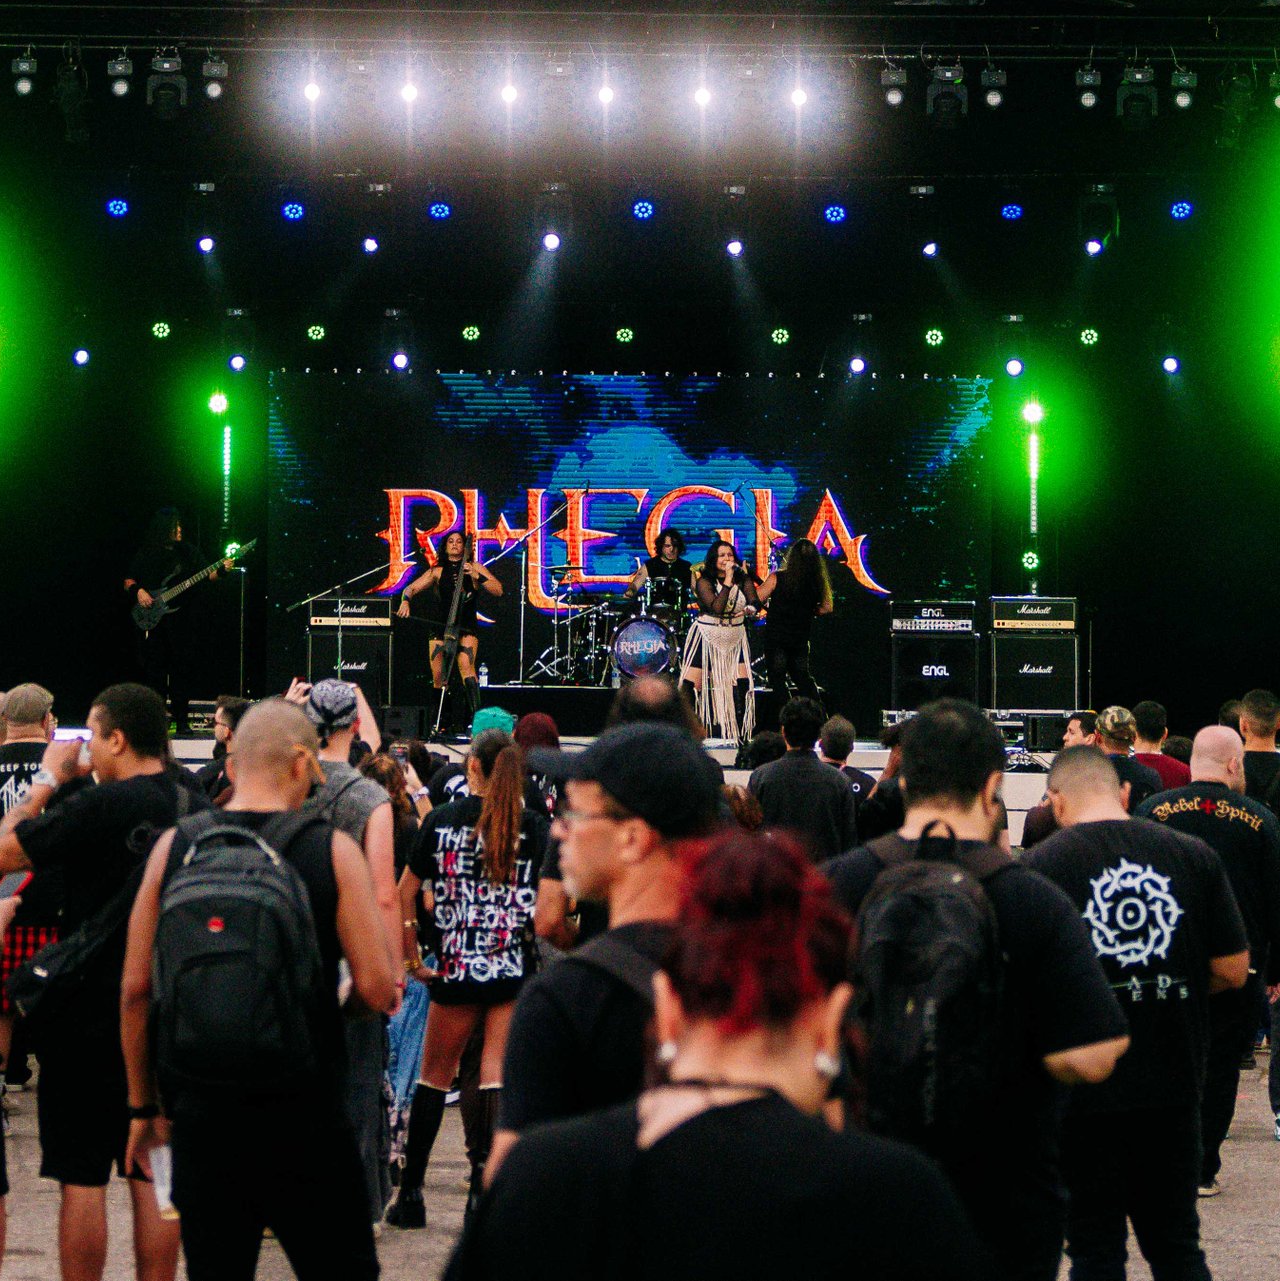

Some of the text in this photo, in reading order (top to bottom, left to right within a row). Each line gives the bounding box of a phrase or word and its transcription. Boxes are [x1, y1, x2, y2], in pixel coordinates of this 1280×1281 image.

[333, 602, 368, 613] Marshall
[921, 608, 944, 618] ENGL
[1016, 603, 1052, 615] Marshall
[333, 659, 368, 670] Marshall
[1019, 663, 1053, 674] Marshall
[921, 665, 950, 677] ENGL
[1152, 796, 1264, 832] Rebel Spirit
